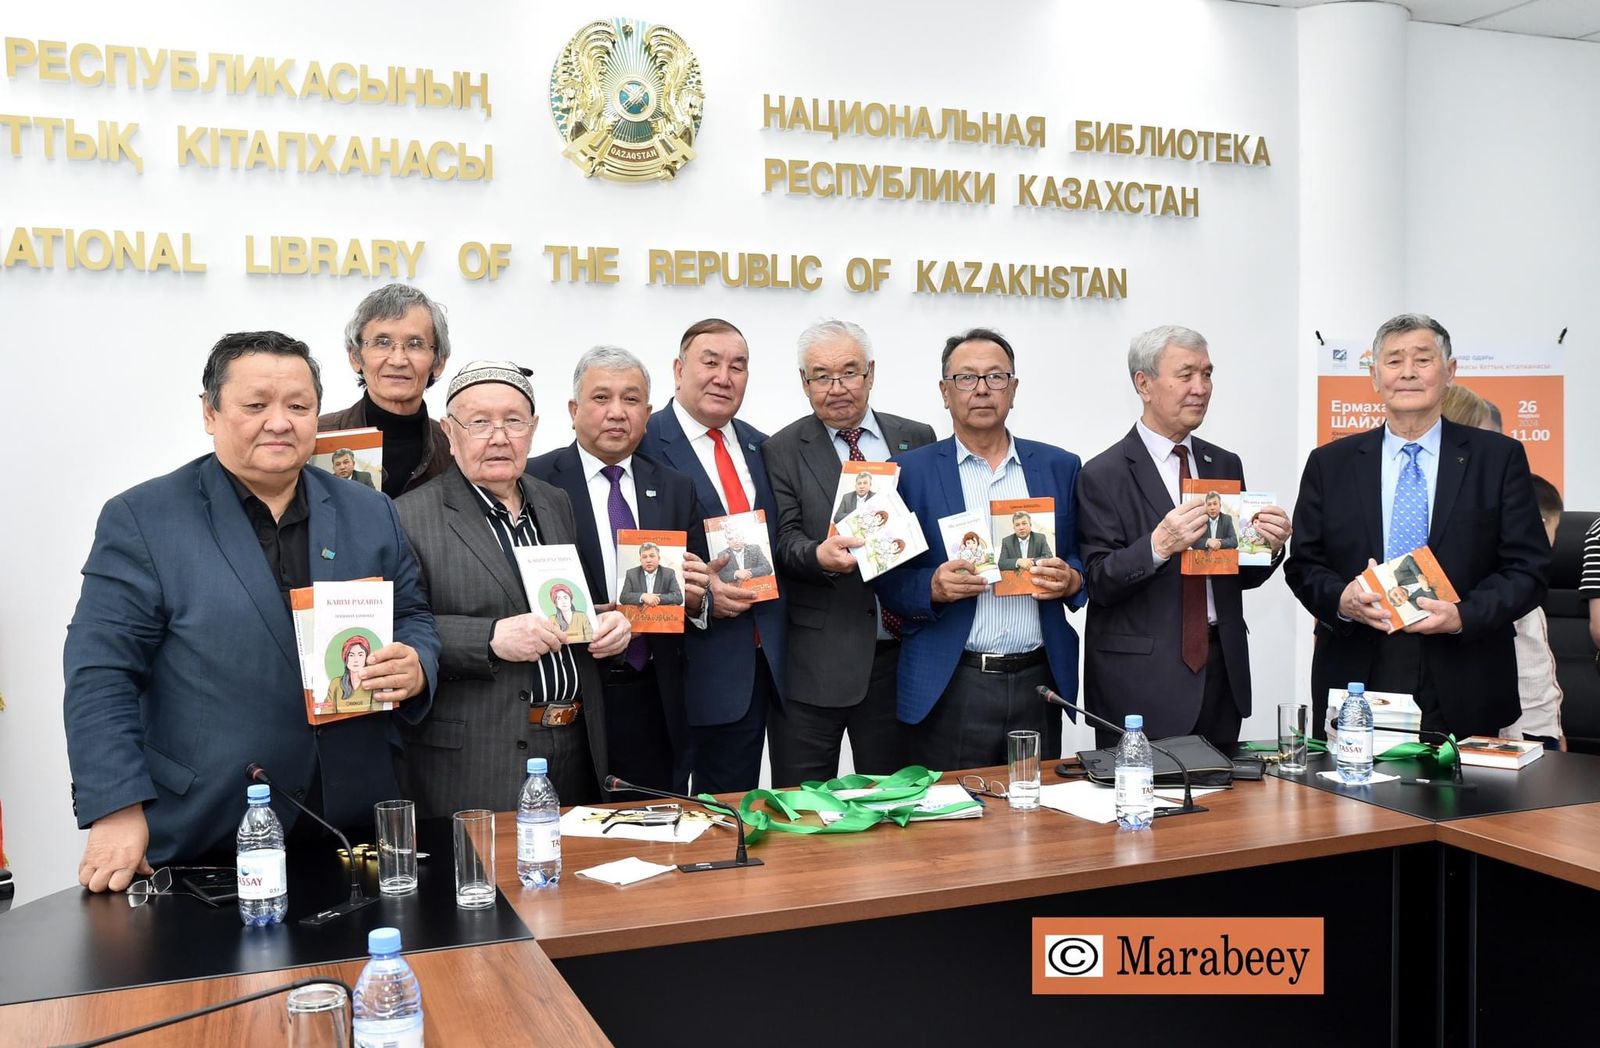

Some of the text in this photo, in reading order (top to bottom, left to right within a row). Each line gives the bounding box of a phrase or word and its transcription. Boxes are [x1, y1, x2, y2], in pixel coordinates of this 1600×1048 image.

[5, 37, 492, 119] РЕСПУБЛИКАСЫНЫҢ
[0, 114, 494, 181] ТТЫҚ КІТАПХАНАСЫ
[610, 147, 657, 160] QAZAQSTAN
[763, 94, 1270, 166] НАЦИОНАЛЬНАЯ БИБЛИОТЕКА
[764, 158, 1199, 217] РЕСПУБЛИКИ КАЗАХСТАН
[245, 235, 426, 279] LIBRARY
[458, 241, 512, 281] OF
[544, 245, 619, 283] THE
[648, 249, 823, 291] REPUBLIC
[846, 258, 891, 292] OF
[916, 260, 1127, 299] KAZAKHSTAN
[1510, 429, 1550, 441] 11.00
[1518, 400, 1537, 413] 26
[1339, 744, 1362, 753] TASSAY
